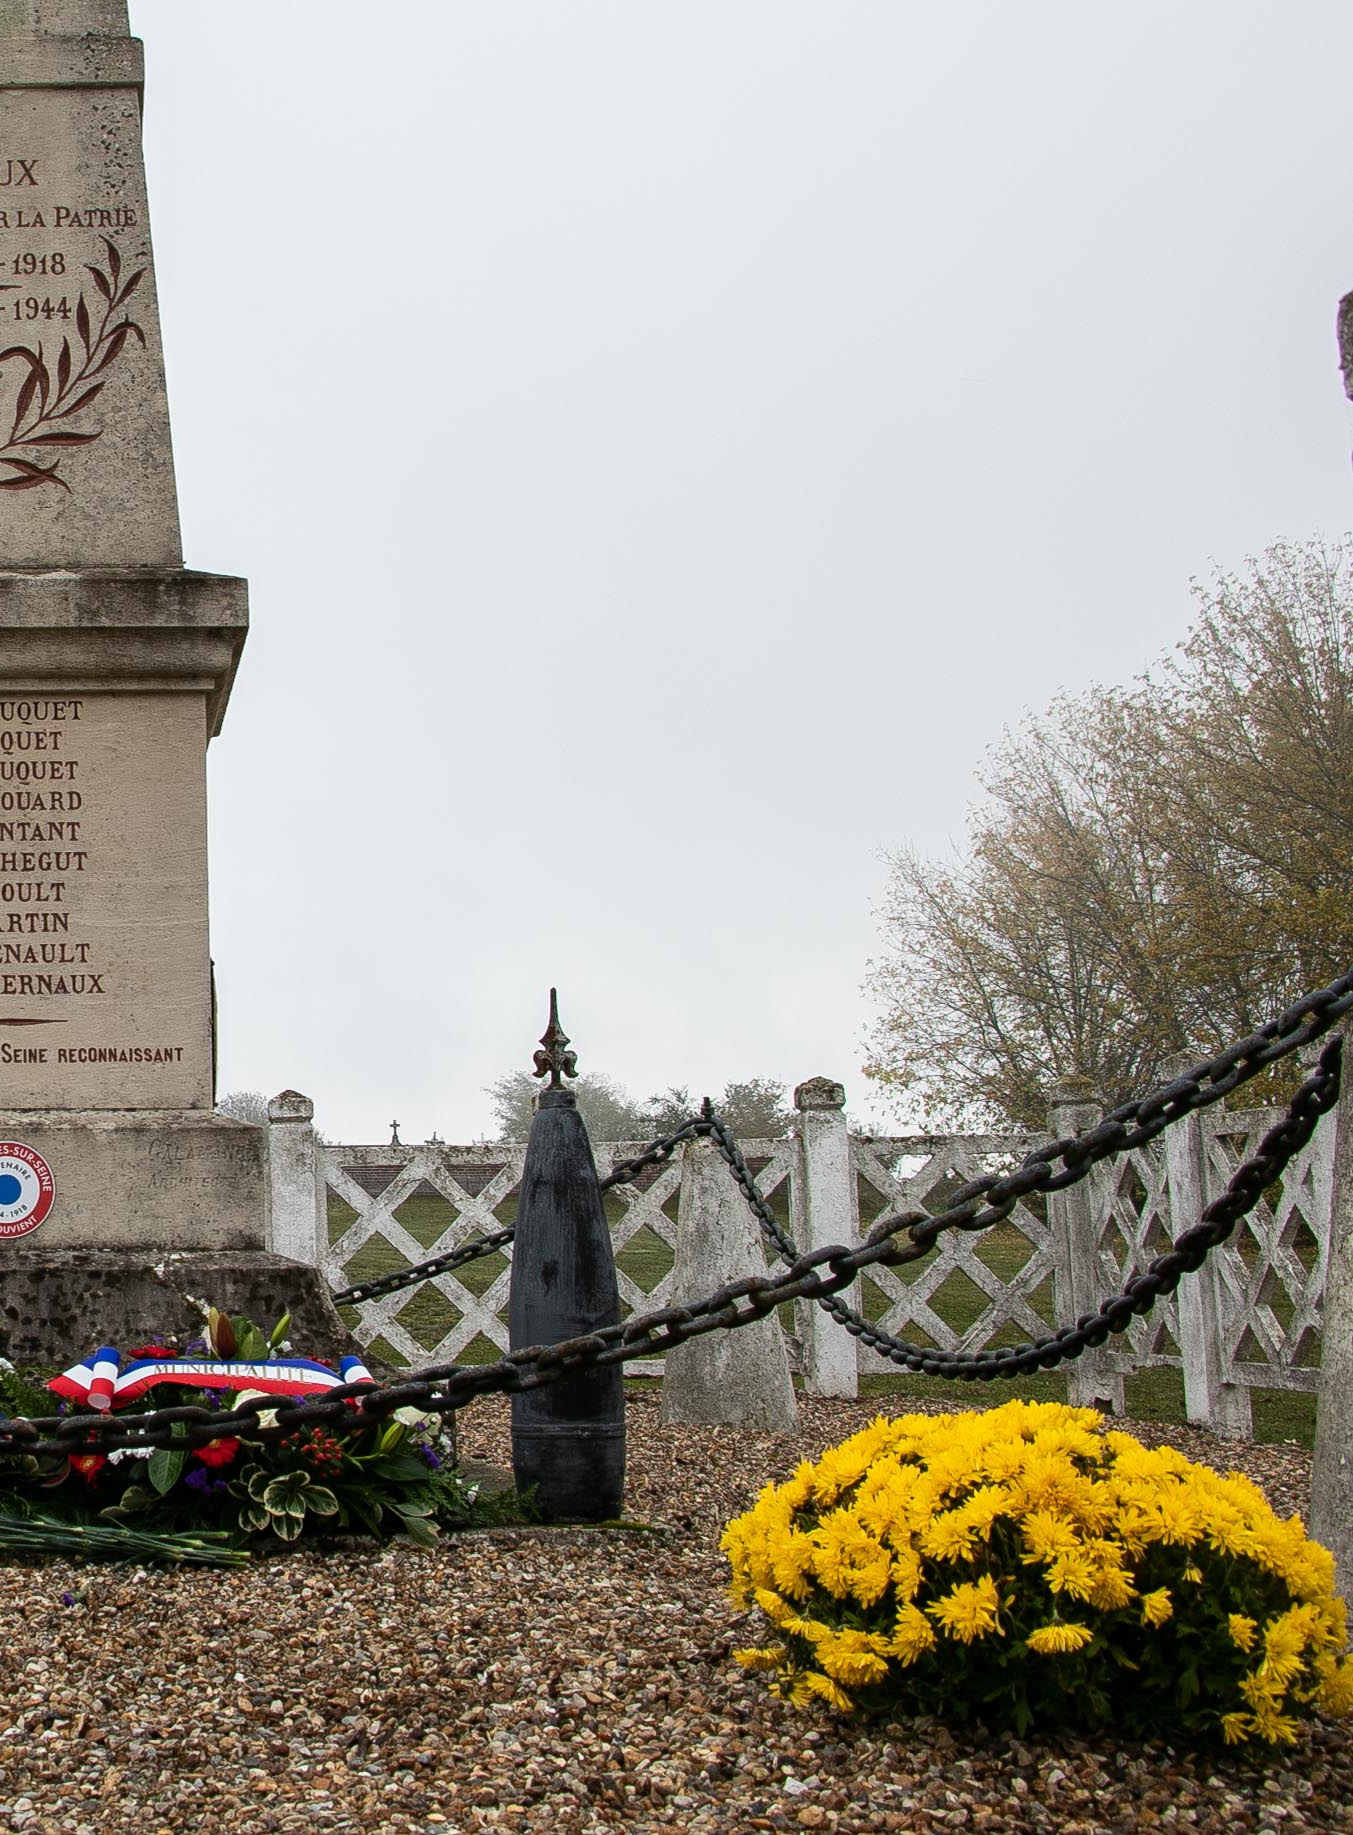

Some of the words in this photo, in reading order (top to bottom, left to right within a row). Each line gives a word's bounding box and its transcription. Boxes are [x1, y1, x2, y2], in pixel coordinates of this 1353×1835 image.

[16, 210, 46, 228] LA
[53, 206, 138, 228] PATRIE
[57, 1046, 184, 1064] RECONNAISSANT
